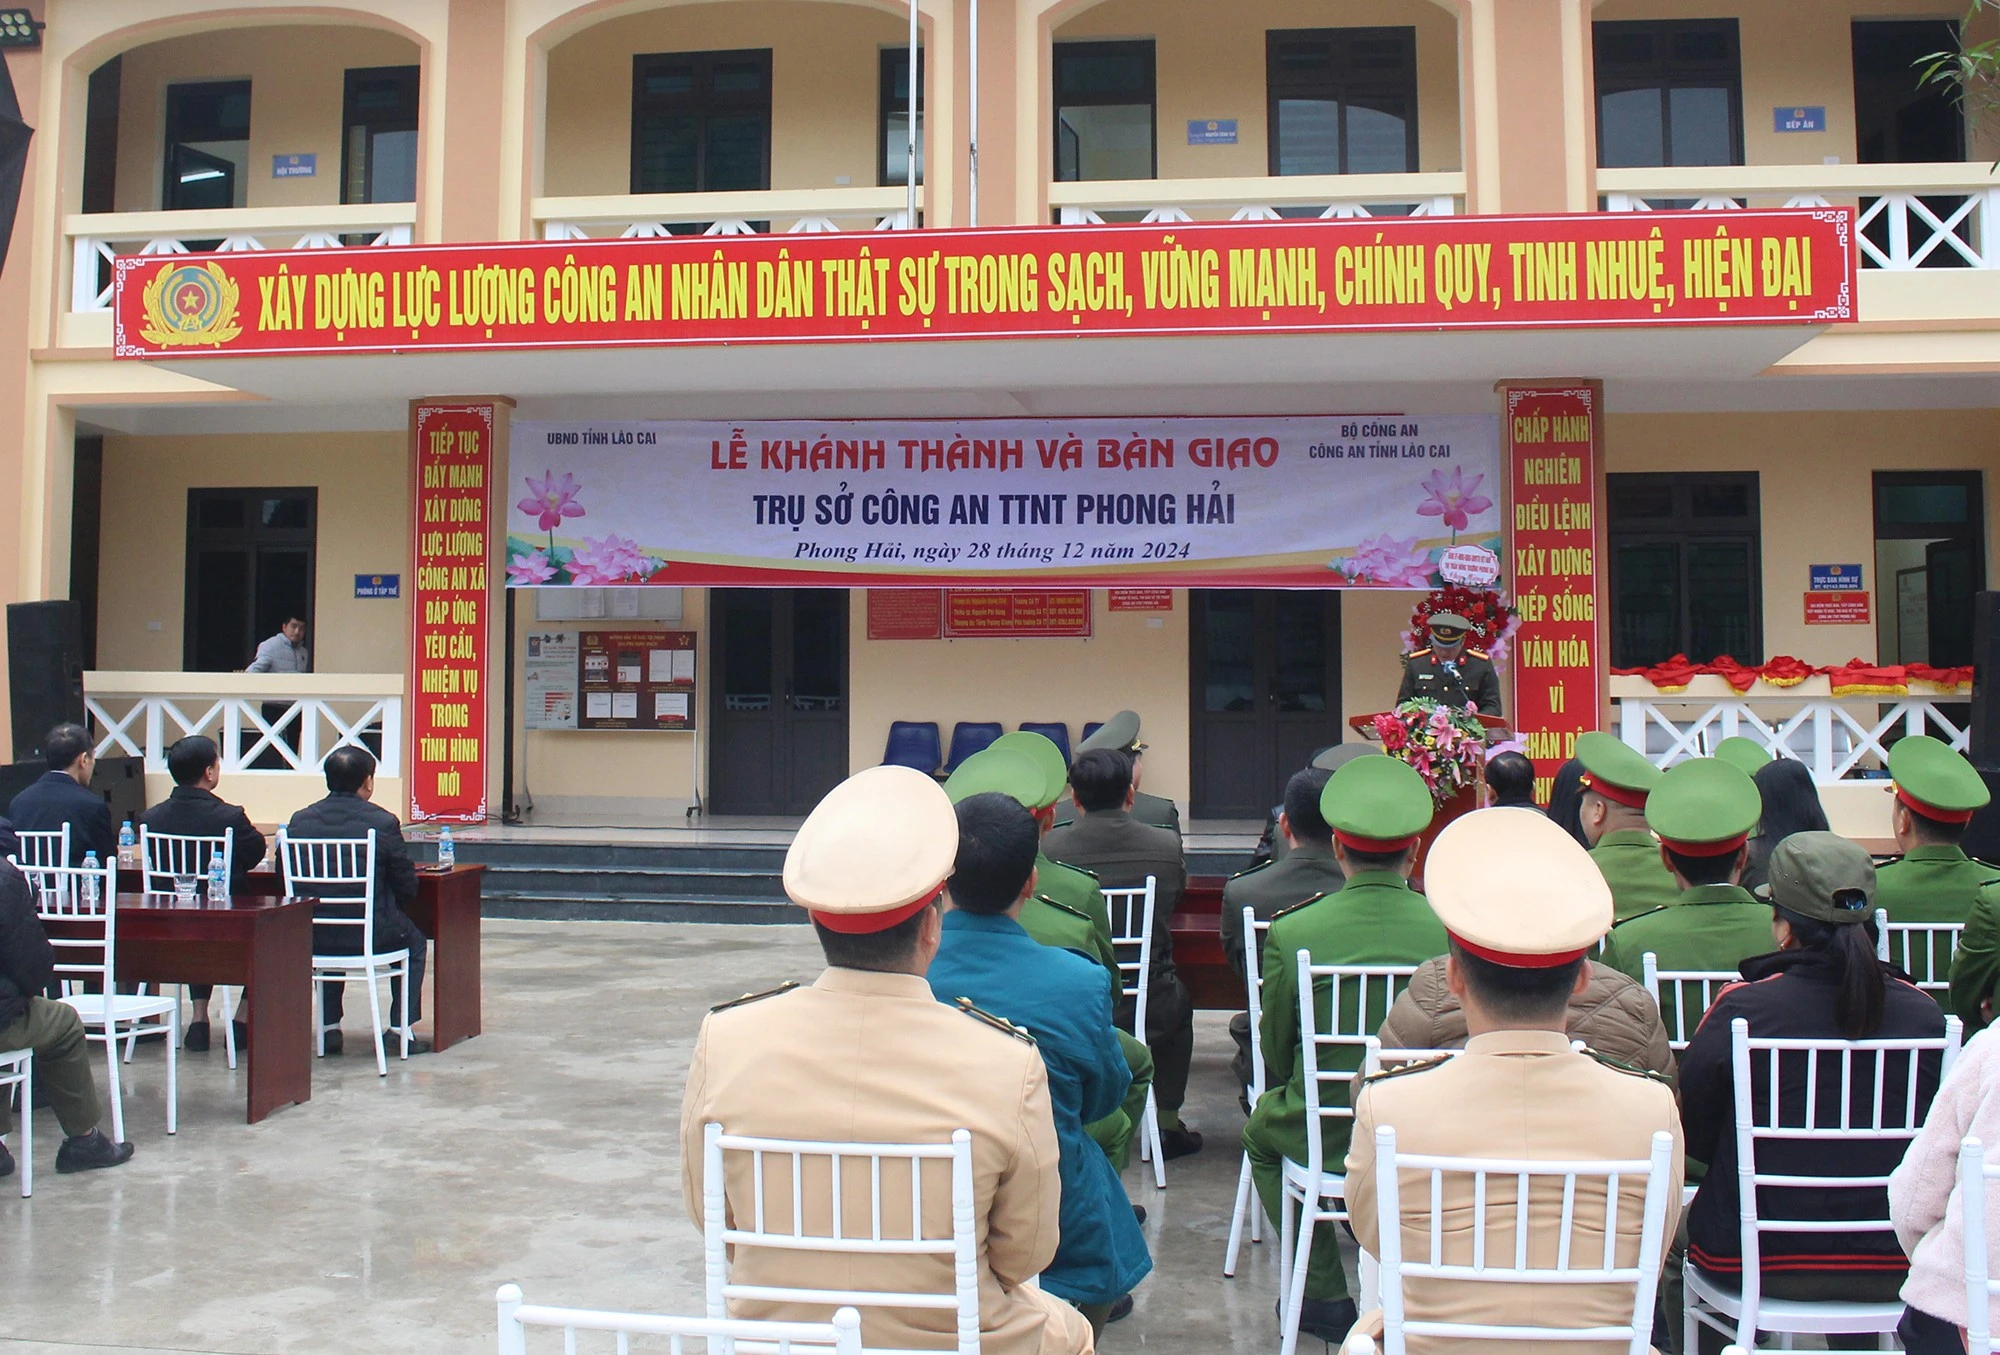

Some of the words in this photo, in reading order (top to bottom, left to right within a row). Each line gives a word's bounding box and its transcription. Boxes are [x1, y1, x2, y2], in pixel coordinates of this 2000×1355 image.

[259, 264, 305, 331] XÂY
[315, 266, 384, 341] DỰNG
[393, 264, 441, 338] LỰC
[450, 263, 535, 338] LƯỢNG
[544, 254, 617, 324] CÔNG
[625, 263, 663, 321] AN
[672, 249, 748, 320] NHÂN
[757, 248, 814, 319] DÂN
[822, 245, 890, 330] THẬT
[899, 250, 939, 328] SỰ
[945, 252, 1038, 312] TRONG
[1048, 251, 1133, 324] SẠCH,
[1142, 235, 1220, 310] VỮNG
[1230, 247, 1326, 321] MẠNH,
[1335, 232, 1426, 306] CHÍNH
[1435, 243, 1501, 310] QUY,
[1509, 241, 1577, 302] TINH
[1586, 226, 1675, 313] NHUỆ,
[1684, 225, 1754, 312] HIỆN
[1762, 236, 1812, 310] ĐẠI
[430, 423, 455, 454] TIẾP
[458, 430, 480, 458] TỤC
[547, 432, 579, 445] UBND
[582, 427, 609, 445] TỈNH
[612, 428, 634, 445] LÀO
[637, 432, 657, 445] CAI
[1341, 422, 1359, 440] BỘ
[1362, 421, 1396, 438] CÔNG
[1400, 424, 1418, 437] AN
[1514, 406, 1549, 443] CHẤP
[1553, 410, 1589, 443] HÀNH
[711, 429, 748, 470] LỄ
[761, 434, 885, 472] KHÁNH
[898, 433, 1024, 473] THÀNH
[1036, 433, 1083, 470] VÀ
[1097, 431, 1174, 471] BÀN
[1188, 436, 1280, 470] GIAO
[1309, 442, 1344, 459] CÔNG
[1347, 445, 1366, 459] AN
[1369, 440, 1398, 459] TỈNH
[1402, 441, 1426, 459] LÀO
[1429, 444, 1450, 459] CAI
[424, 456, 447, 489] ĐẨY
[449, 465, 483, 491] MẠNH
[1524, 452, 1581, 485] NGHIÊM
[424, 494, 447, 522] XÂY
[449, 498, 481, 527] DỰNG
[753, 493, 805, 532] TRỤ
[815, 481, 855, 526] SỞ
[862, 488, 940, 526] CÔNG
[948, 494, 990, 525] AN
[999, 493, 1068, 525] TTNT
[1076, 493, 1177, 525] PHONG
[1186, 479, 1236, 525] HẢI
[1516, 494, 1550, 531] ĐIỀU
[1554, 497, 1592, 536] LỆNH
[422, 531, 444, 561] LỰC
[446, 531, 483, 561] LƯỢNG
[794, 542, 859, 564] Phong
[864, 542, 908, 562] Hải,
[913, 545, 962, 565] ngày
[967, 542, 991, 560] 28
[997, 541, 1054, 564] tháng
[1062, 542, 1086, 560] 12
[1091, 543, 1135, 560] năm
[1142, 542, 1191, 560] 2024
[1517, 543, 1547, 576] XÂY
[1551, 545, 1593, 581] DỰNG
[418, 560, 449, 591] CÔNG
[451, 566, 468, 590] AN
[470, 561, 486, 590] XÃ
[425, 595, 449, 625] ĐÁP
[452, 594, 477, 625] ỨNG
[1518, 584, 1548, 622] NẾP
[1553, 584, 1594, 622] SỐNG
[424, 629, 446, 660] YÊU
[449, 626, 477, 662] CẦU,
[1522, 635, 1554, 667] VĂN
[1558, 634, 1590, 667] HÓA
[422, 666, 460, 698] NHIỆM
[462, 670, 479, 698] VỤ
[1549, 680, 1565, 713] VÌ
[430, 703, 469, 729] TRONG
[420, 732, 448, 763] TÌNH
[450, 732, 479, 763] HÌNH
[437, 767, 461, 797] MỚI
